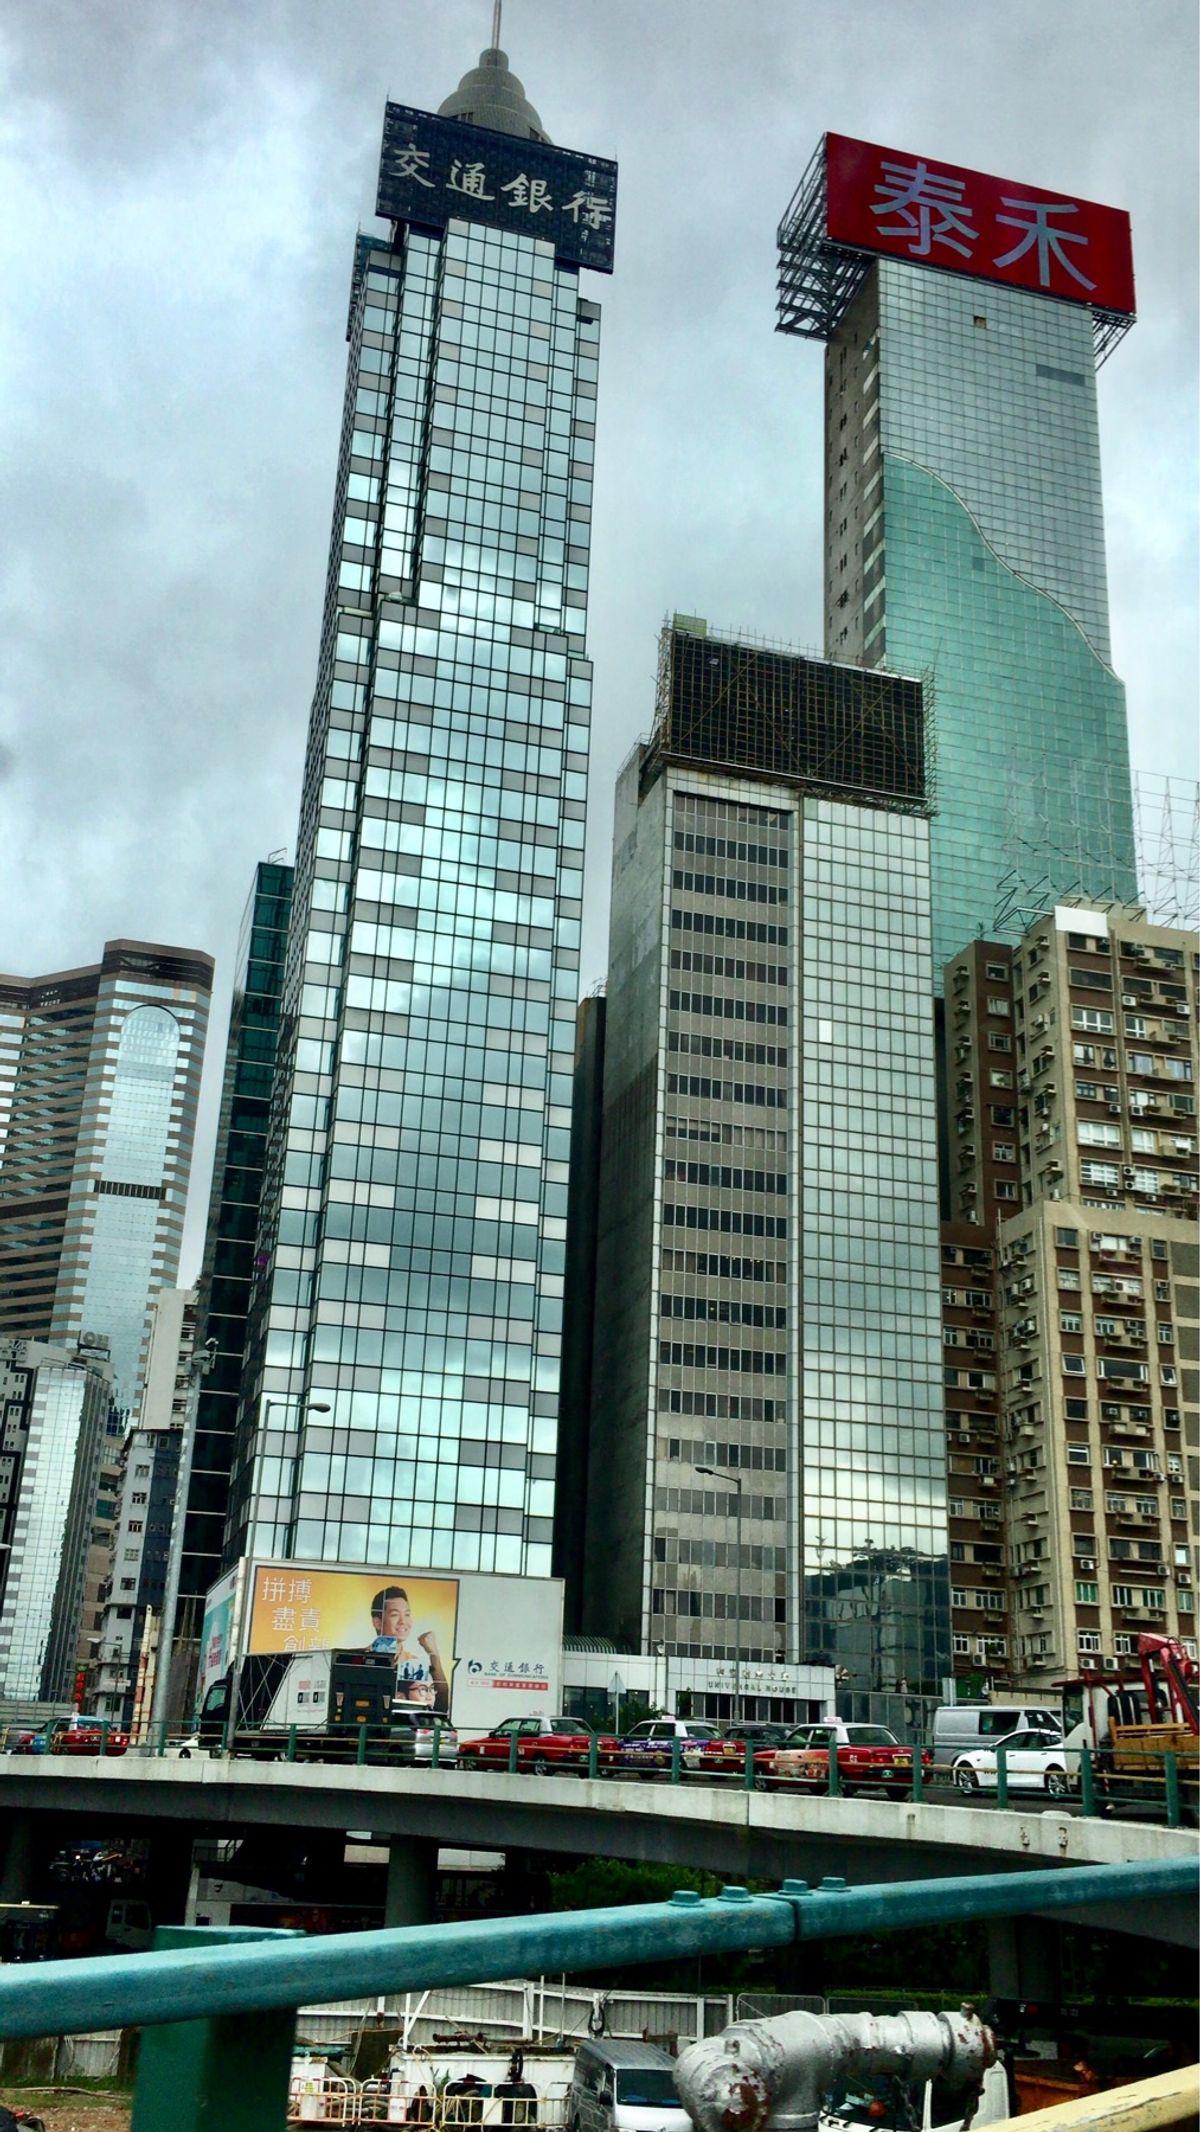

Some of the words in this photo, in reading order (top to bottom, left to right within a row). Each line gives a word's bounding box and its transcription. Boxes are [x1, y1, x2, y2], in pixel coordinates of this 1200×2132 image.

[388, 142, 612, 230] 交通銀行
[868, 160, 1098, 291] 泰禾
[261, 1575, 313, 1604] 拼搏
[271, 1605, 321, 1633] 盡責
[489, 1660, 545, 1675] 交通銀行
